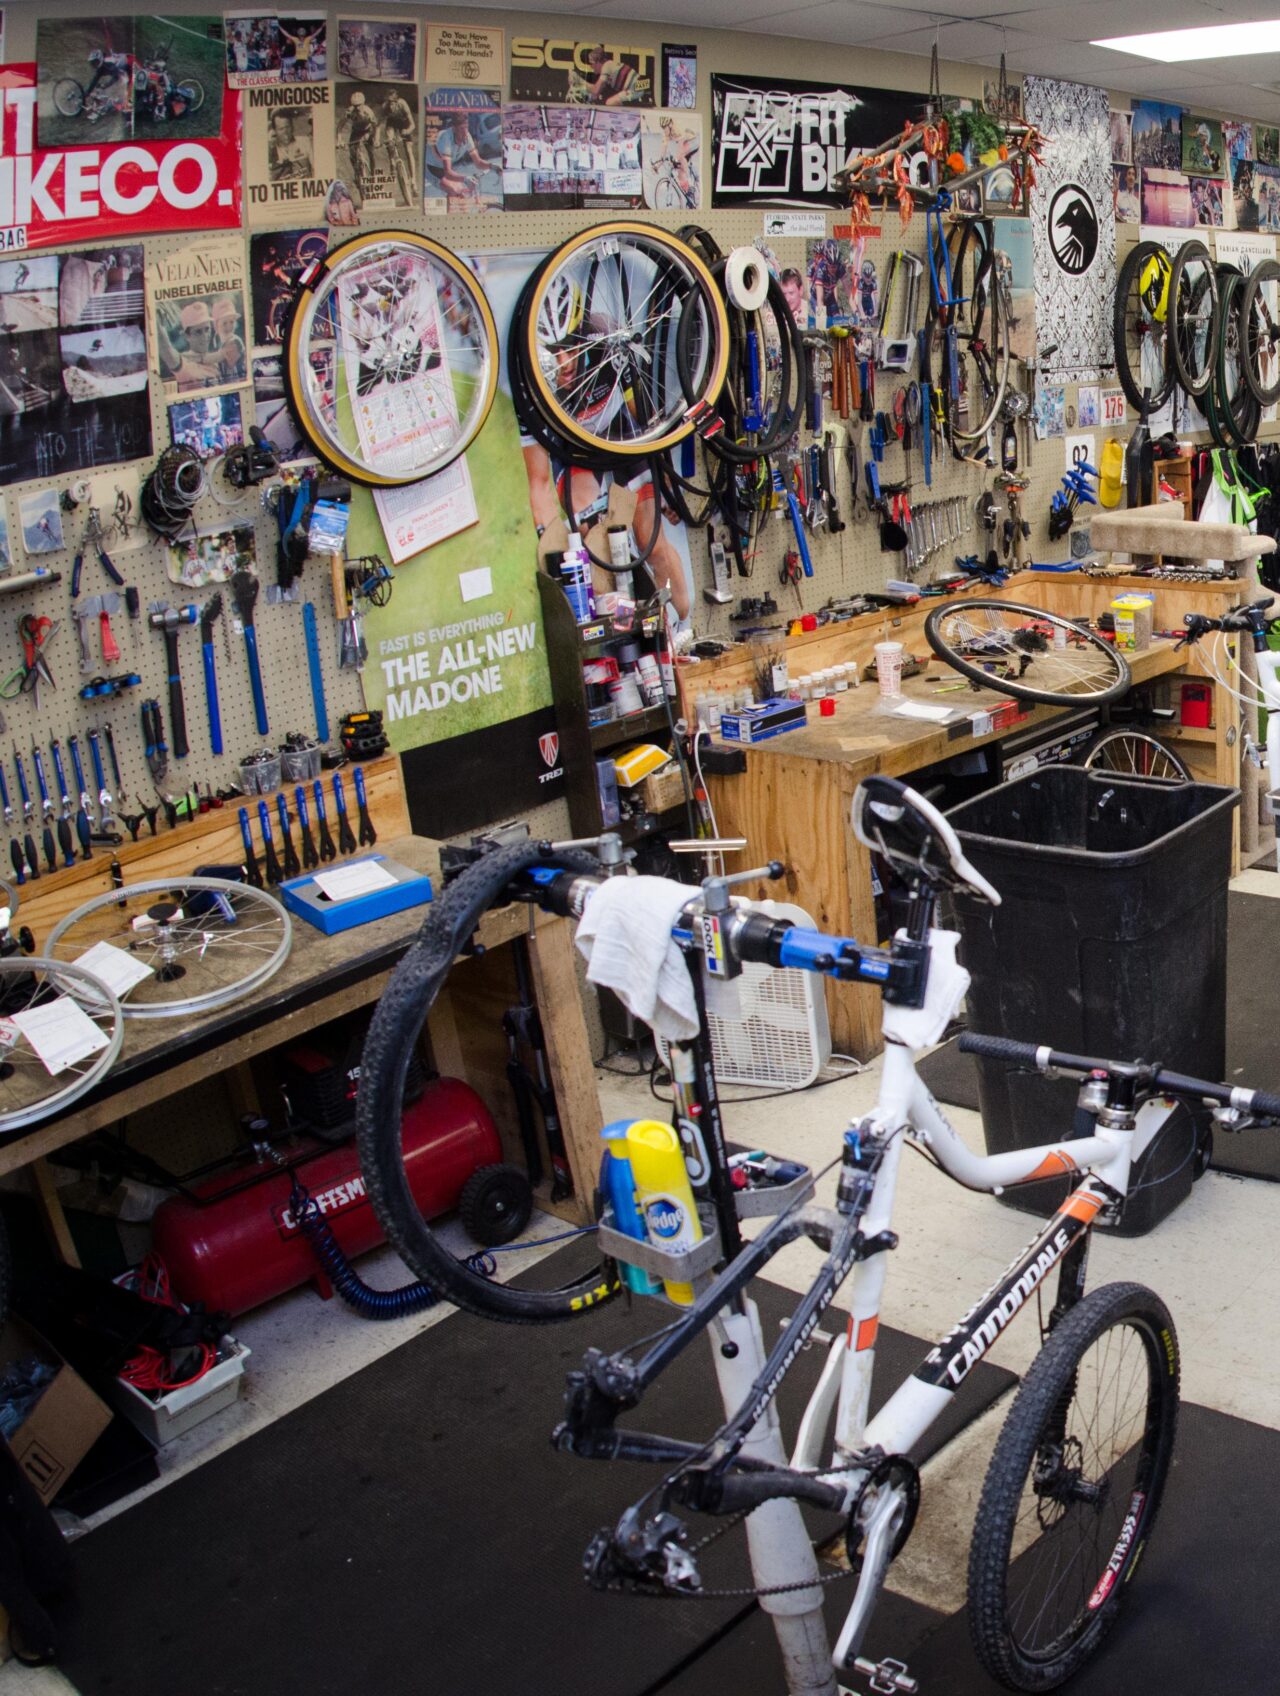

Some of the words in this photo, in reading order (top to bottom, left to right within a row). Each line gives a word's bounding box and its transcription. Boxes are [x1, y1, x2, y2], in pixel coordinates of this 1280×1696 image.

[438, 38, 451, 48] Too
[453, 39, 473, 49] Much
[474, 41, 491, 51] Time
[442, 30, 453, 41] Do
[455, 31, 467, 42] You
[469, 32, 488, 42] Have
[435, 47, 447, 55] On
[449, 48, 465, 58] Your
[466, 48, 493, 59] Hands?
[249, 87, 329, 108] MONGOOSE
[801, 97, 852, 145] FIT
[249, 184, 268, 204] TO
[271, 181, 299, 201] THE
[1219, 244, 1240, 254] FABIAN
[154, 279, 243, 301] UNBELIEVABLE!
[1104, 397, 1124, 419] 176
[380, 635, 411, 656] FAST
[413, 632, 427, 648] IS
[428, 612, 504, 643] EVERYTHING
[381, 651, 431, 689] THE
[437, 622, 536, 676] ALL-NEW
[386, 665, 503, 722] MADONE
[702, 915, 715, 959] LOOK
[752, 1311, 817, 1421] HANDMADE
[819, 1287, 833, 1309] IN
